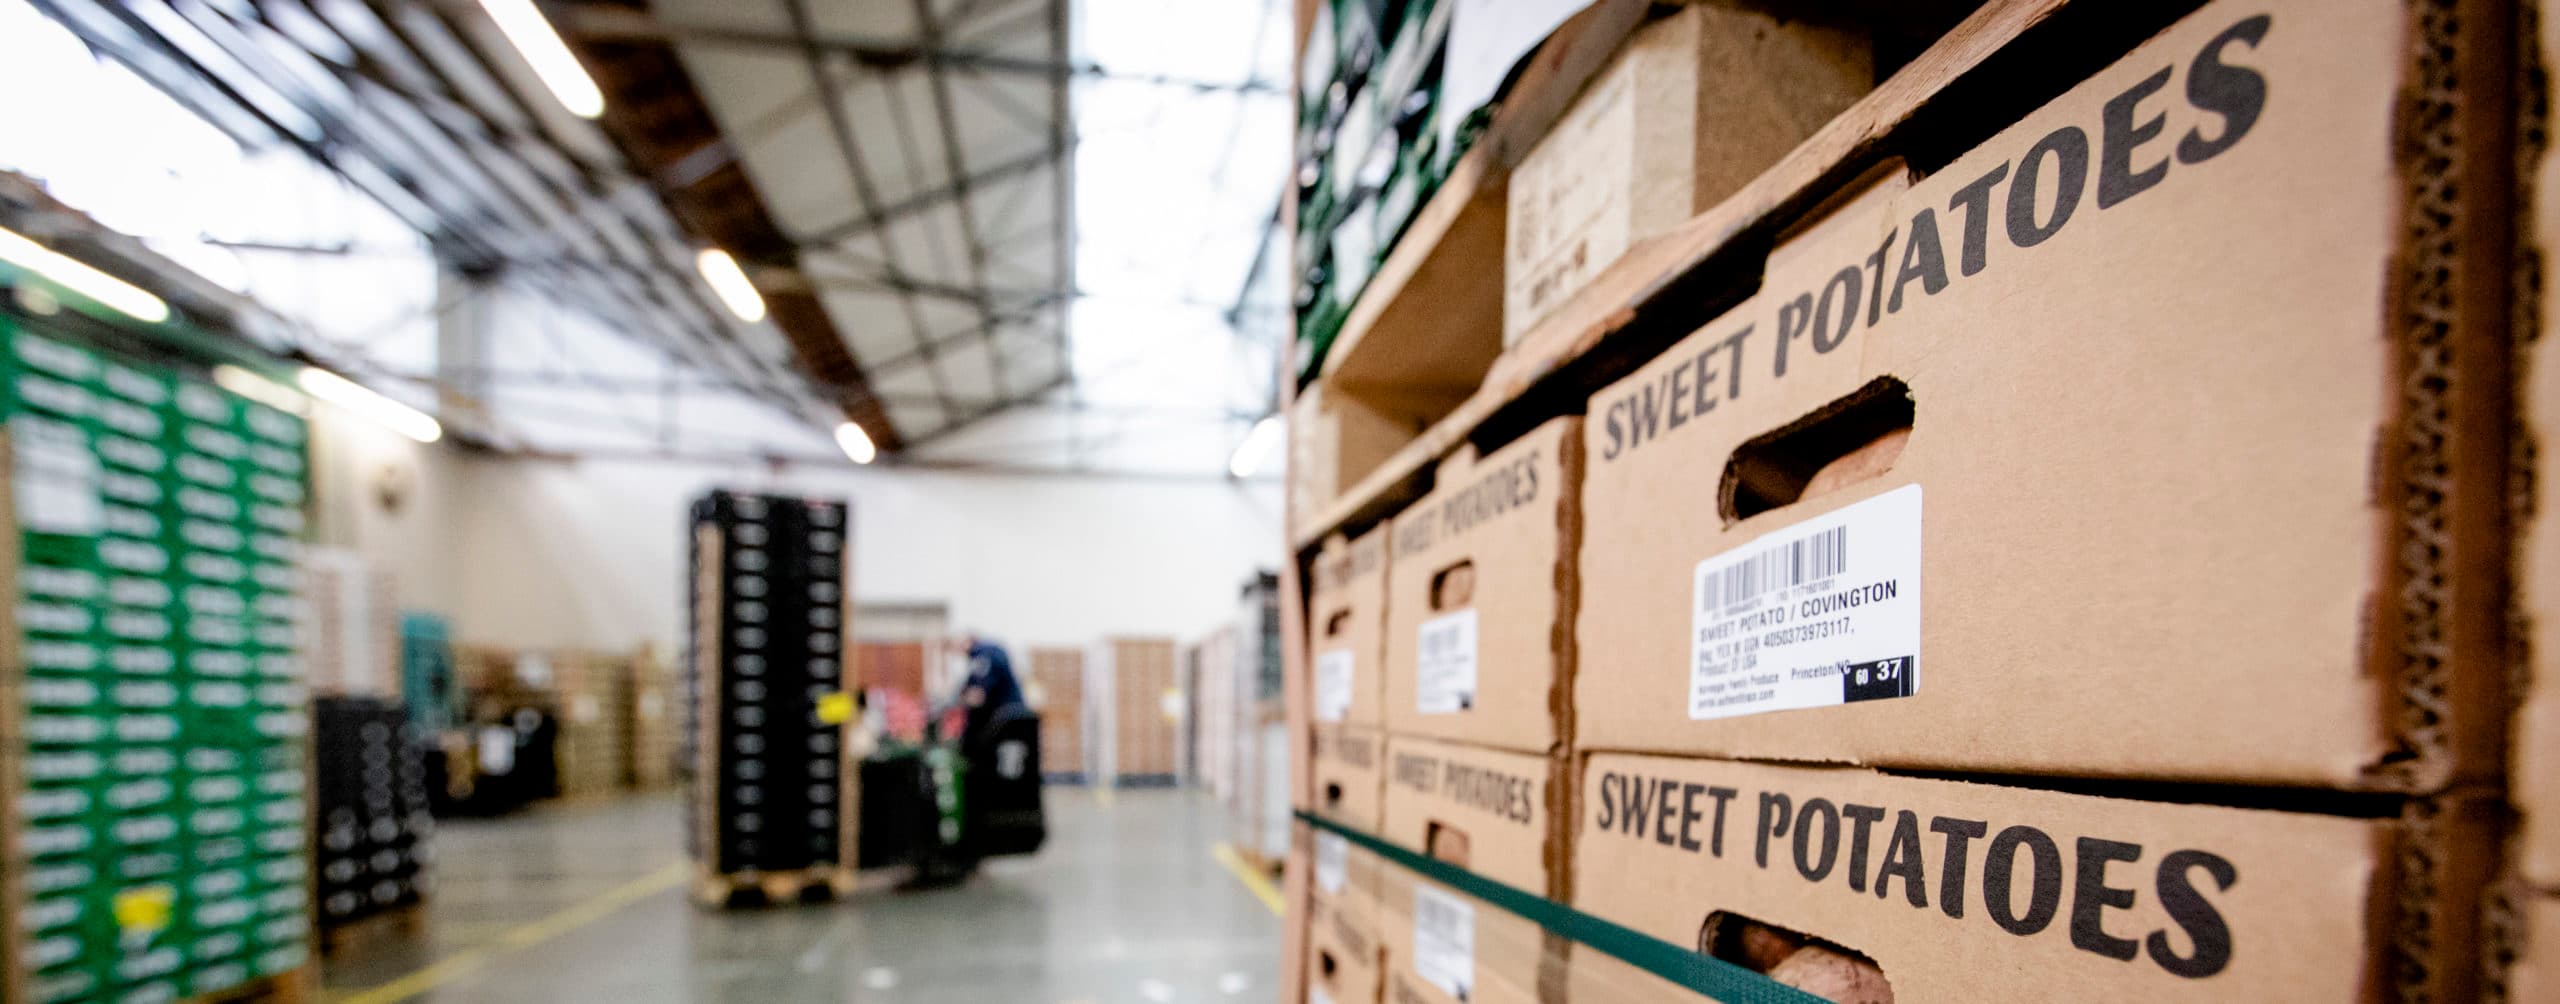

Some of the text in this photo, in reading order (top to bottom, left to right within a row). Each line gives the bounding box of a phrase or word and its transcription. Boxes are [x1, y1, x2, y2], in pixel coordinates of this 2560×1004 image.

[1602, 14, 2271, 462] SWEET POTATOES
[1443, 450, 1539, 536] POTATOES
[1701, 620, 1735, 643] SWEET
[1740, 607, 1785, 632] POTATO
[1790, 604, 1796, 621] /
[1802, 579, 1896, 618] COVINGTON
[1791, 659, 1851, 680] Princeton/NC
[1877, 659, 1902, 681] 37
[1396, 755, 1531, 825] SWEET POTATOES
[1598, 771, 2237, 979] SWEET POTATOES
